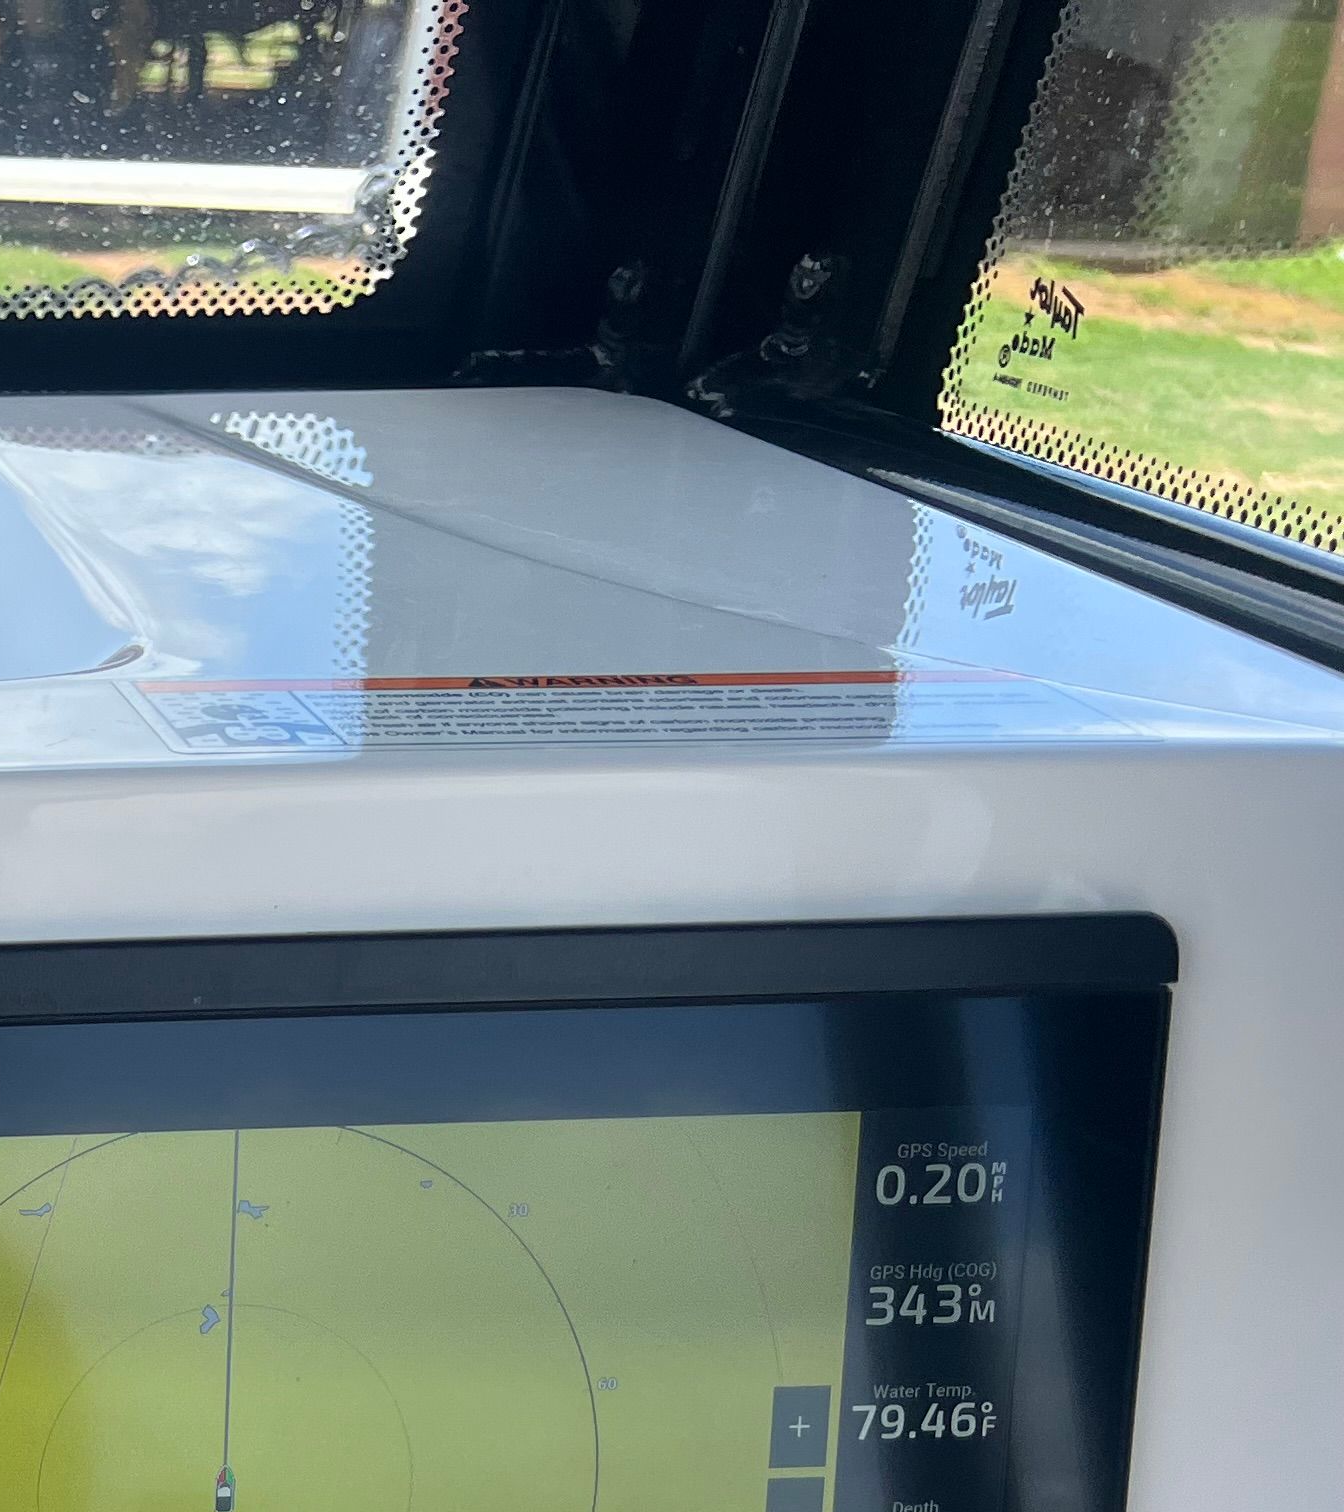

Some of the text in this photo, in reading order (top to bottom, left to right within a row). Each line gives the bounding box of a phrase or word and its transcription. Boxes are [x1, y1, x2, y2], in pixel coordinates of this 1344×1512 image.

[897, 1140, 989, 1161] GPS Speed
[875, 1162, 988, 1206] 0.20
[869, 1261, 998, 1282] GPS Hdg (COG)
[873, 1382, 977, 1401] Water Temp.
